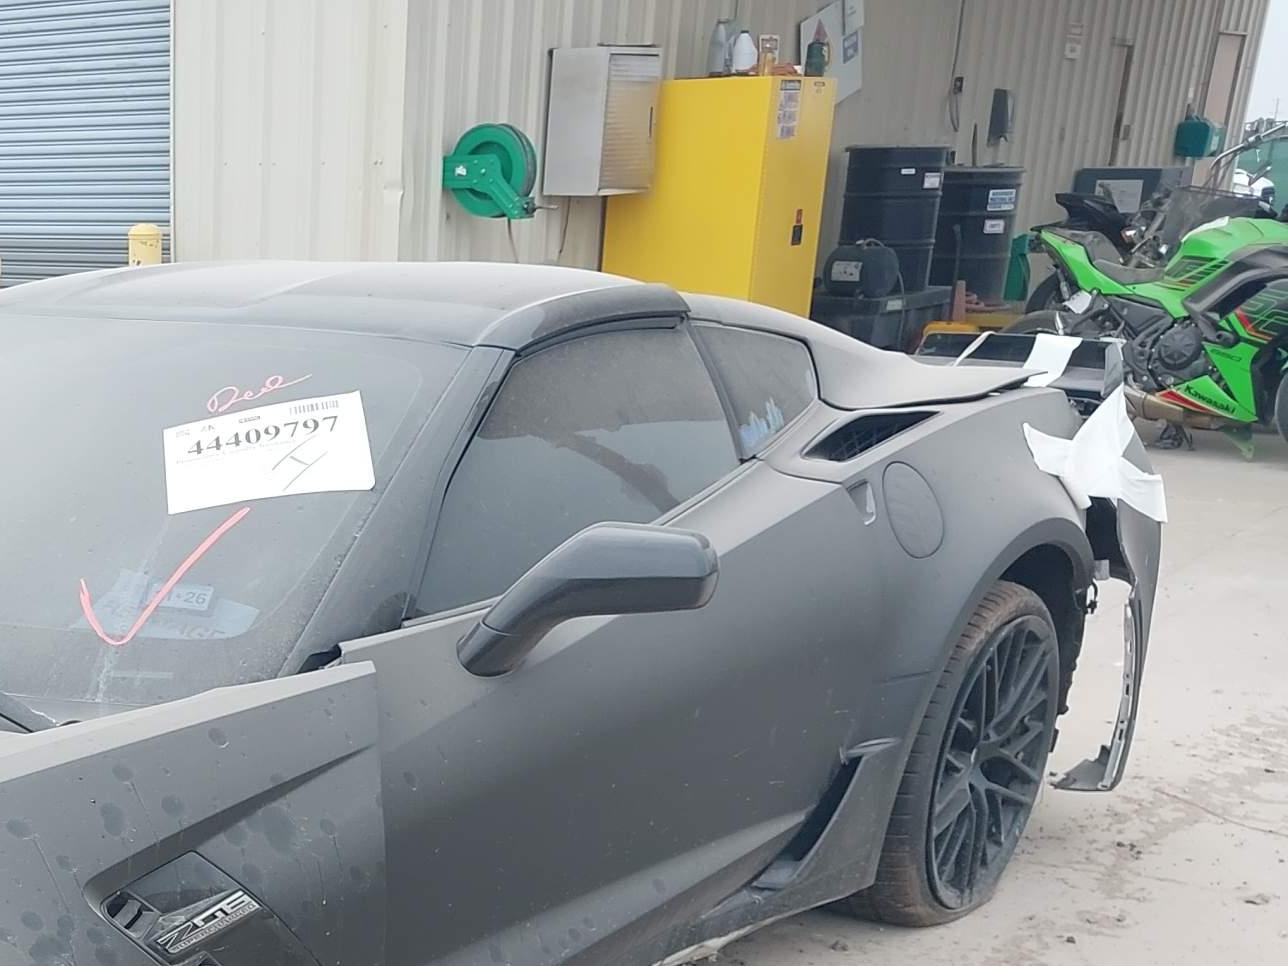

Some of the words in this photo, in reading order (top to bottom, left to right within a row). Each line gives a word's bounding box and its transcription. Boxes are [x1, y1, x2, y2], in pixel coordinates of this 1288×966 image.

[1184, 384, 1236, 414] Kawasaki
[187, 415, 339, 455] 44409797
[156, 890, 253, 949] Z06
